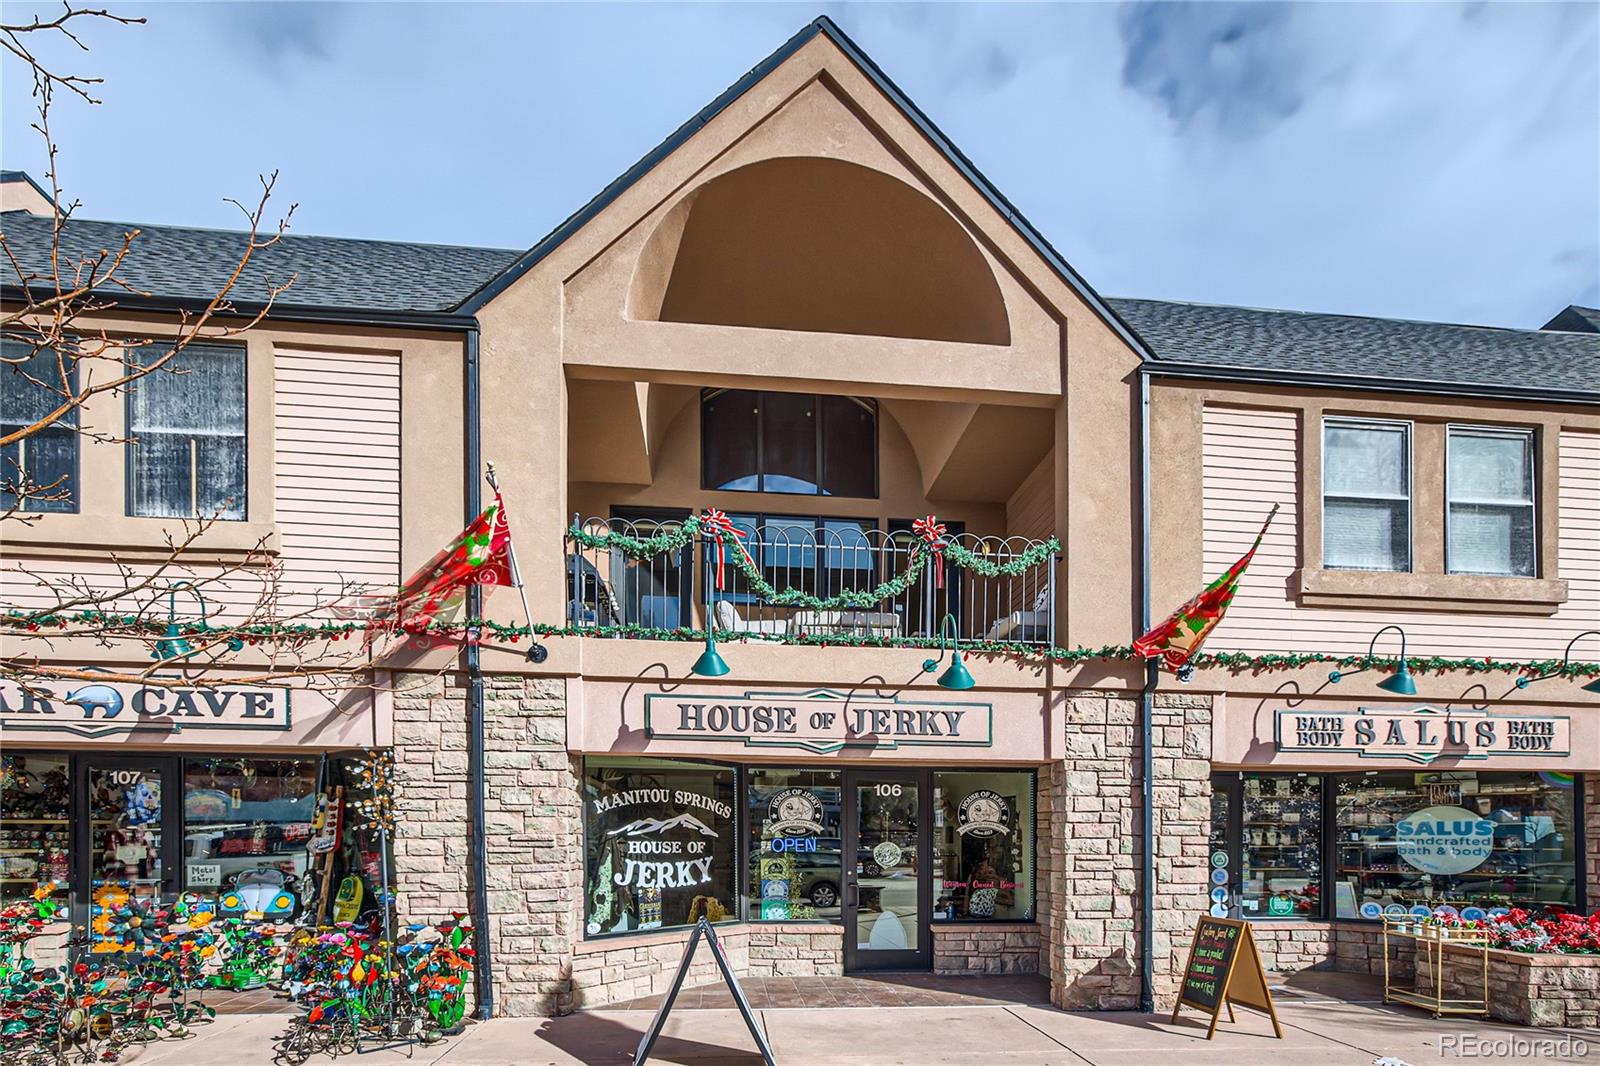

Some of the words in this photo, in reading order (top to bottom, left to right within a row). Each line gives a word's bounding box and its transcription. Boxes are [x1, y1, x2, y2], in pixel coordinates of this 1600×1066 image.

[131, 689, 275, 718] CAVE
[676, 703, 797, 733] HOUSE
[809, 711, 836, 729] OF
[849, 708, 966, 736] JERKY
[1296, 716, 1344, 732] BATH
[1354, 718, 1497, 747] SALUS
[1507, 720, 1555, 736] BATH
[1296, 731, 1343, 746] BODY
[1508, 735, 1553, 750] BODY
[110, 771, 141, 784] 107
[874, 784, 902, 797] 106
[593, 788, 670, 814] MANITOU
[674, 790, 732, 819] SPRINGS
[772, 790, 791, 809] HOUSE
[802, 791, 820, 809] JERKY
[961, 792, 980, 810] HOUSE
[990, 794, 1008, 811] JERKY
[1397, 820, 1493, 836] SALUS
[628, 840, 681, 854] HOUSE
[687, 841, 706, 854] OF
[771, 838, 816, 853] OPEN
[1398, 836, 1491, 847] handcrafted
[1398, 846, 1431, 855] bath
[1436, 847, 1447, 855] &
[1452, 846, 1491, 858] body
[614, 856, 713, 889] JERKY
